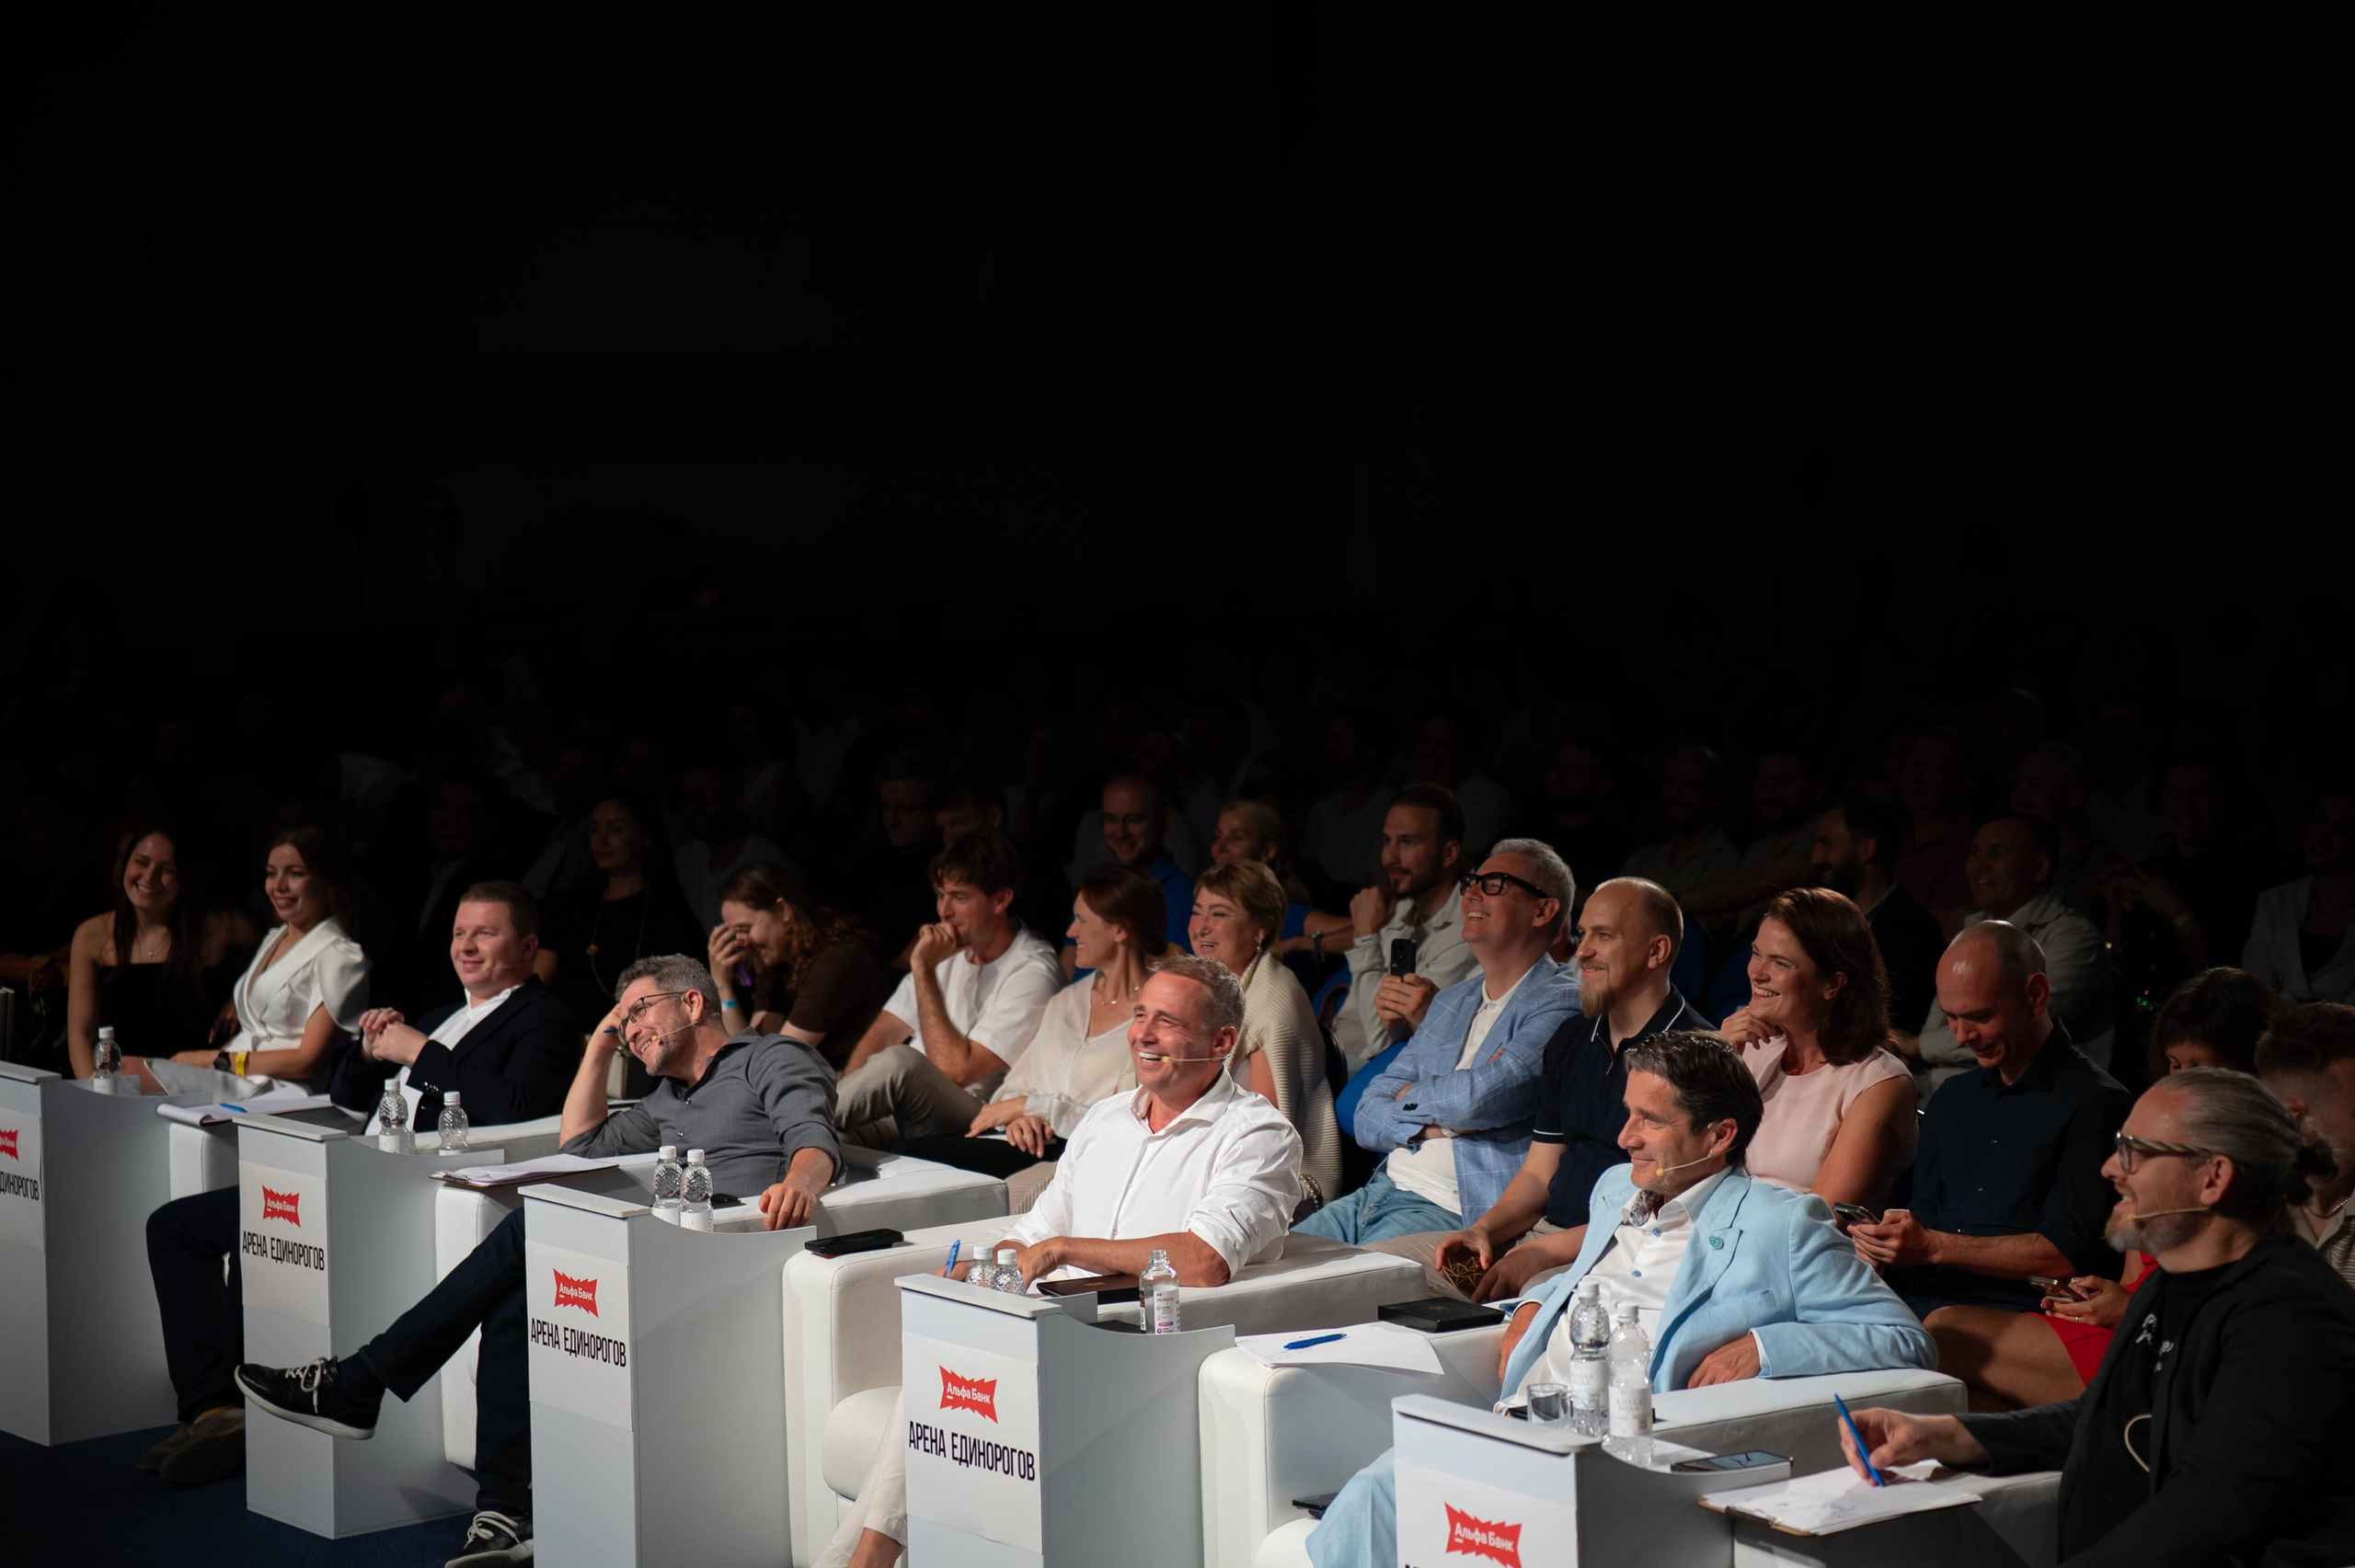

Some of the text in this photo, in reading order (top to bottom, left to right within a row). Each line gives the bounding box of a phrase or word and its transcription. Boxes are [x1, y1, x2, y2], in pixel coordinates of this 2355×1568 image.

[0, 1171, 40, 1201] ДИНОРОГОВ
[243, 1230, 325, 1271] АРЕНА ЕДИНОРОГОВ
[559, 1283, 593, 1301] Альфа Банк
[531, 1318, 626, 1368] АРЕНА ЕДИНОРОГОВ
[947, 1382, 991, 1404] Альфа Банк
[909, 1421, 1036, 1482] АРЕНА ЕДИНОРОГОВ
[1454, 1522, 1514, 1552] Альфа Банк
